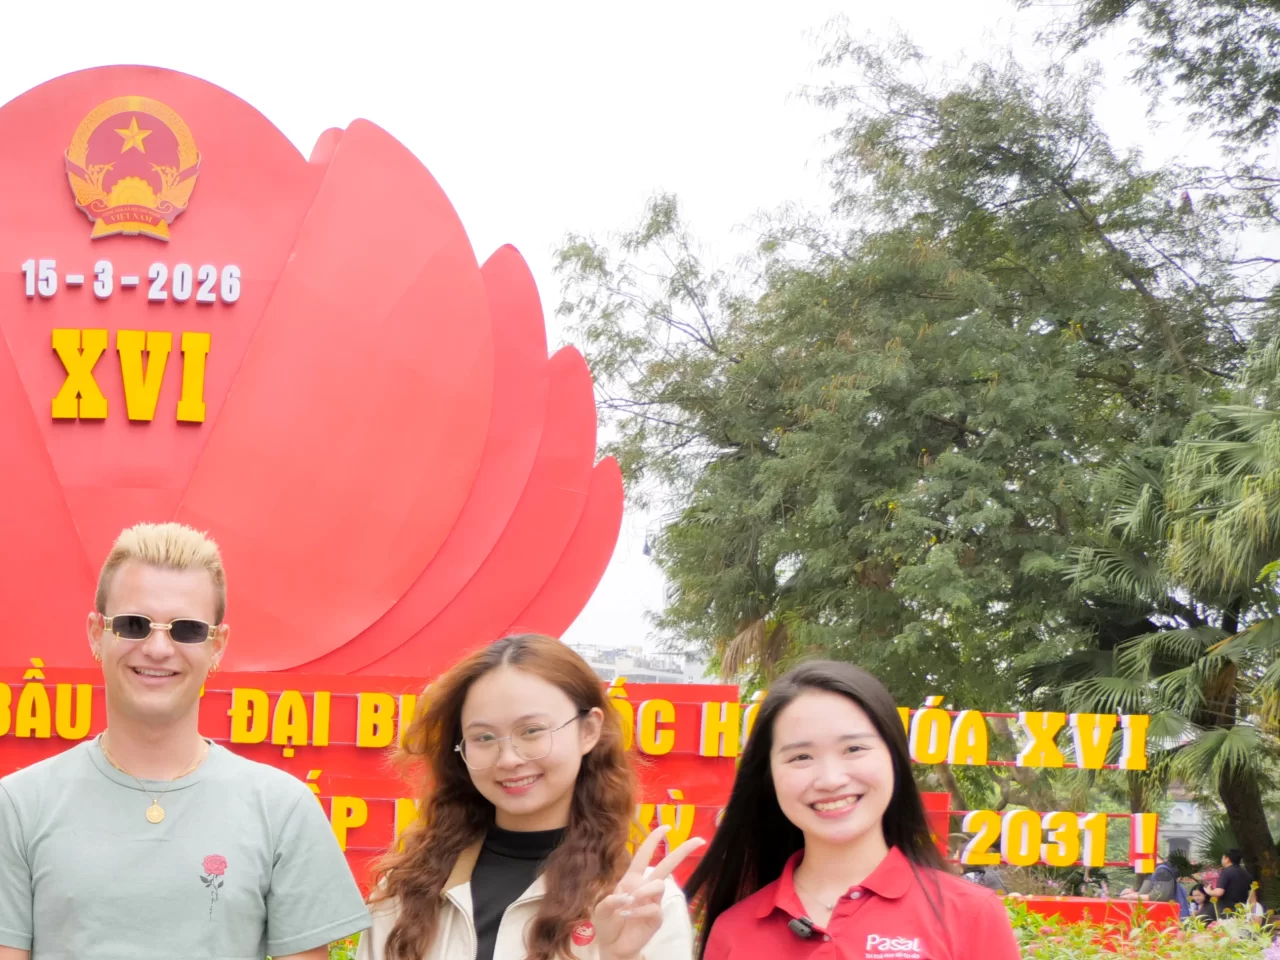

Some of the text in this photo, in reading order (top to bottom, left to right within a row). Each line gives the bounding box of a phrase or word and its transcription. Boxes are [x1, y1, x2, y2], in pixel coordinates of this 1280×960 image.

[52, 328, 211, 422] XVI
[227, 688, 331, 758] ĐẠI
[1016, 711, 1150, 771] XVI
[961, 810, 1108, 867] 2031
[866, 934, 921, 952] Pasal
